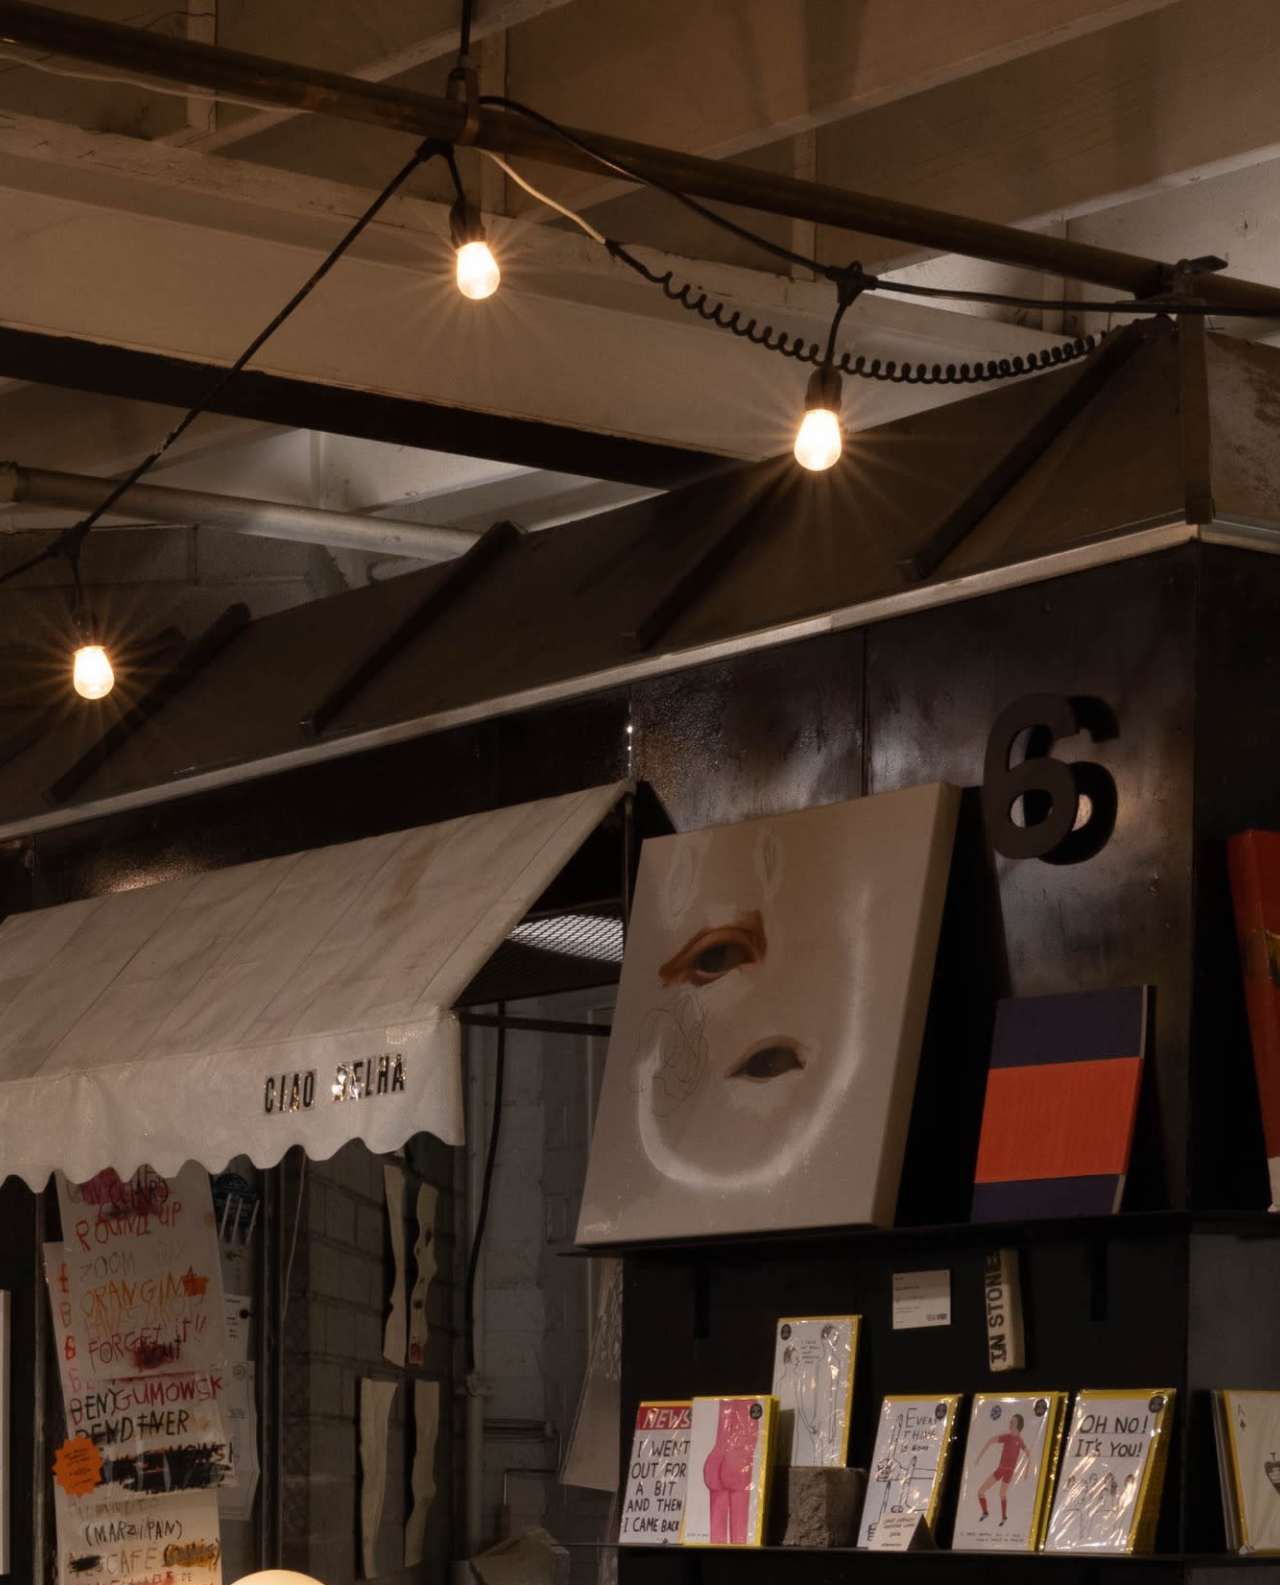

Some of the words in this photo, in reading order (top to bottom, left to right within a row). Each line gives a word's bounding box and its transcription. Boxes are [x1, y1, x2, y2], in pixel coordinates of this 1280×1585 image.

[983, 692, 1092, 861] 6
[264, 1070, 316, 1115] CIAO
[989, 1333, 1007, 1363] IN
[642, 1408, 692, 1429] NEWS
[1079, 1414, 1108, 1434] OH
[1114, 1415, 1149, 1434] NO!
[651, 1439, 690, 1458] WENT
[1109, 1441, 1143, 1458] YOU!
[631, 1462, 658, 1480] OUT
[664, 1462, 687, 1478] FOR
[636, 1483, 644, 1496] A
[654, 1480, 676, 1497] BIT
[626, 1499, 650, 1512] AND
[658, 1499, 682, 1512] THEN
[632, 1516, 659, 1532] CAME
[661, 1519, 680, 1532] BACK
